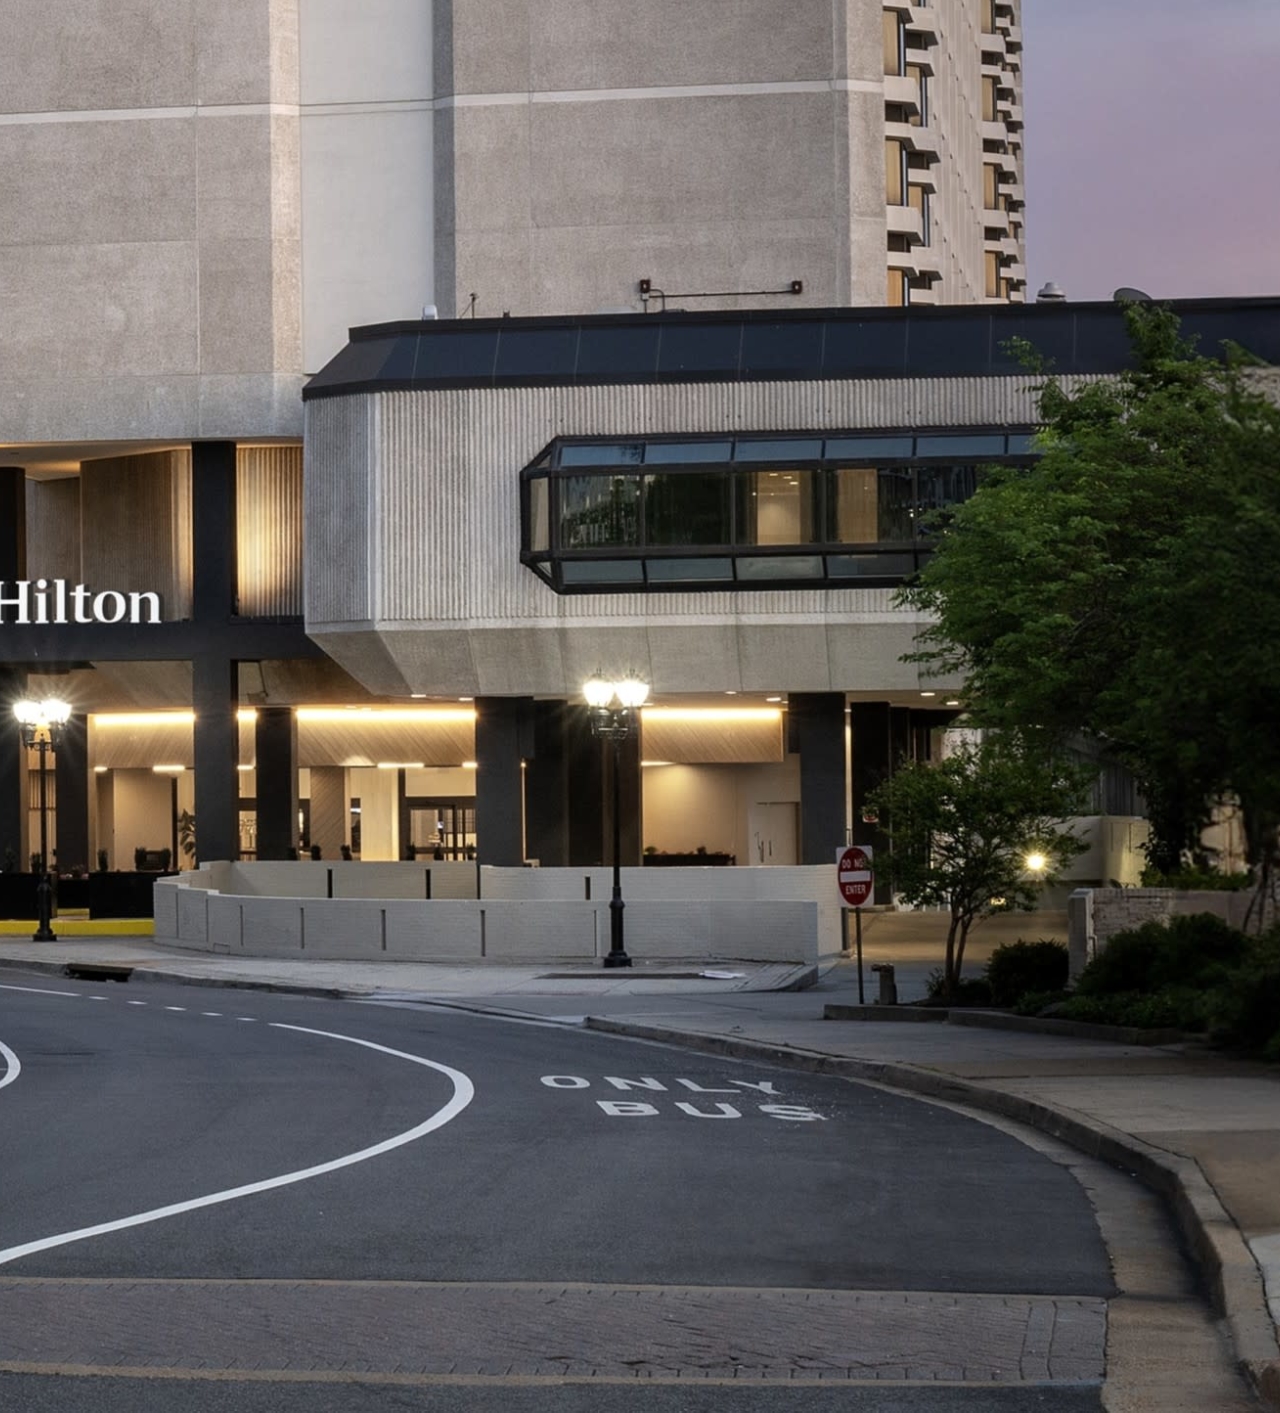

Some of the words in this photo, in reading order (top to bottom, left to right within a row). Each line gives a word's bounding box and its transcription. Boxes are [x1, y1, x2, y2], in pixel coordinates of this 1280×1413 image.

[842, 859, 851, 869] DO
[845, 885, 866, 895] ENTER
[540, 1075, 786, 1095] ONLY
[596, 1100, 828, 1121] BUS
